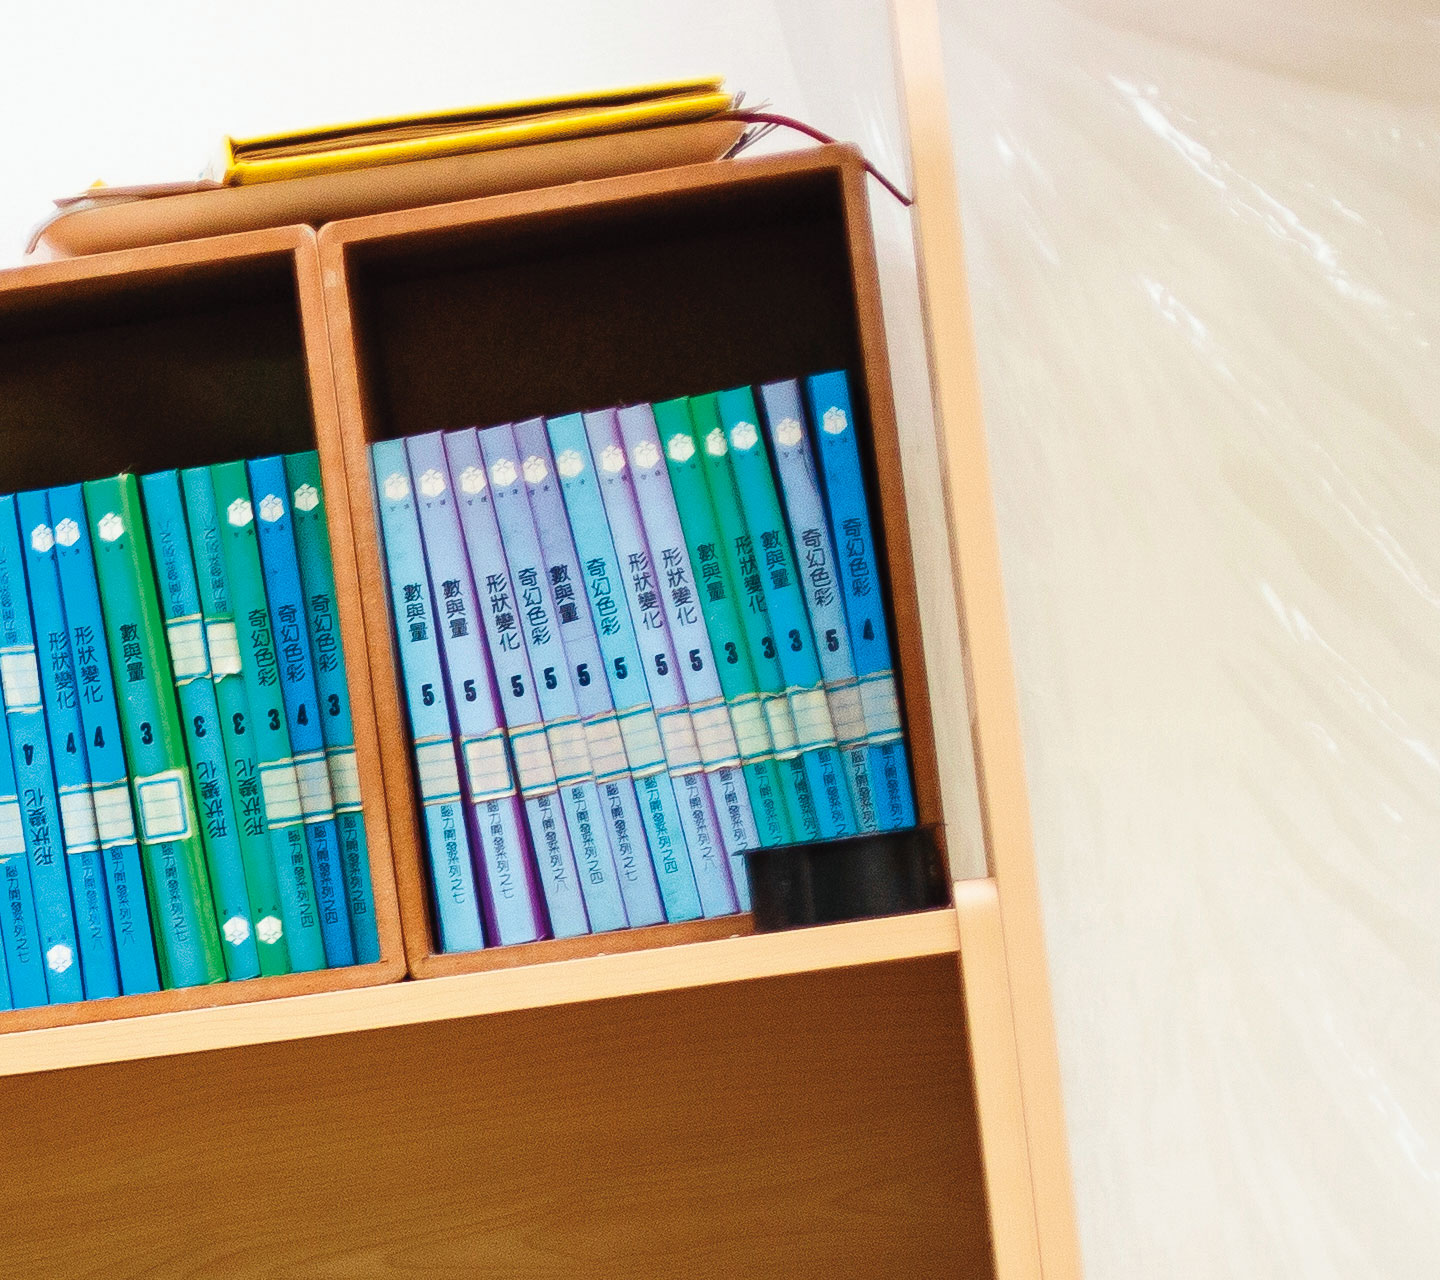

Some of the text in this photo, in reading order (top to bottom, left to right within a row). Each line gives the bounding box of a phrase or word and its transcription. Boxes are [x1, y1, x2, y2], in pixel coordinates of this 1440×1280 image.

[586, 557, 628, 679] 奇幻色彩 5
[628, 551, 669, 676] 形狀變化 5
[662, 547, 703, 671] 形狀變化 5
[696, 543, 738, 664] 數與量 3
[734, 535, 775, 659] 形狀變化 3
[760, 529, 803, 652] 數與量 3
[802, 528, 839, 652] 奇幻色彩 5
[842, 517, 873, 598] 奇幻色彩
[119, 623, 153, 745] 數與量 3
[248, 608, 280, 731] 奇幻色彩 3
[278, 604, 308, 726] 奇幻色彩 4
[311, 593, 340, 716] 奇幻色彩 3
[403, 583, 435, 706] 數與量 5
[441, 579, 477, 702] 數與量 5
[486, 572, 525, 697] 形狀變化 5
[518, 567, 558, 690] 奇幻色彩 5
[549, 564, 591, 686] 數與量 5
[49, 631, 76, 754] 形狀變化 4
[74, 625, 105, 749] 形狀變化 4
[193, 715, 206, 738] 3
[233, 712, 246, 735] 3
